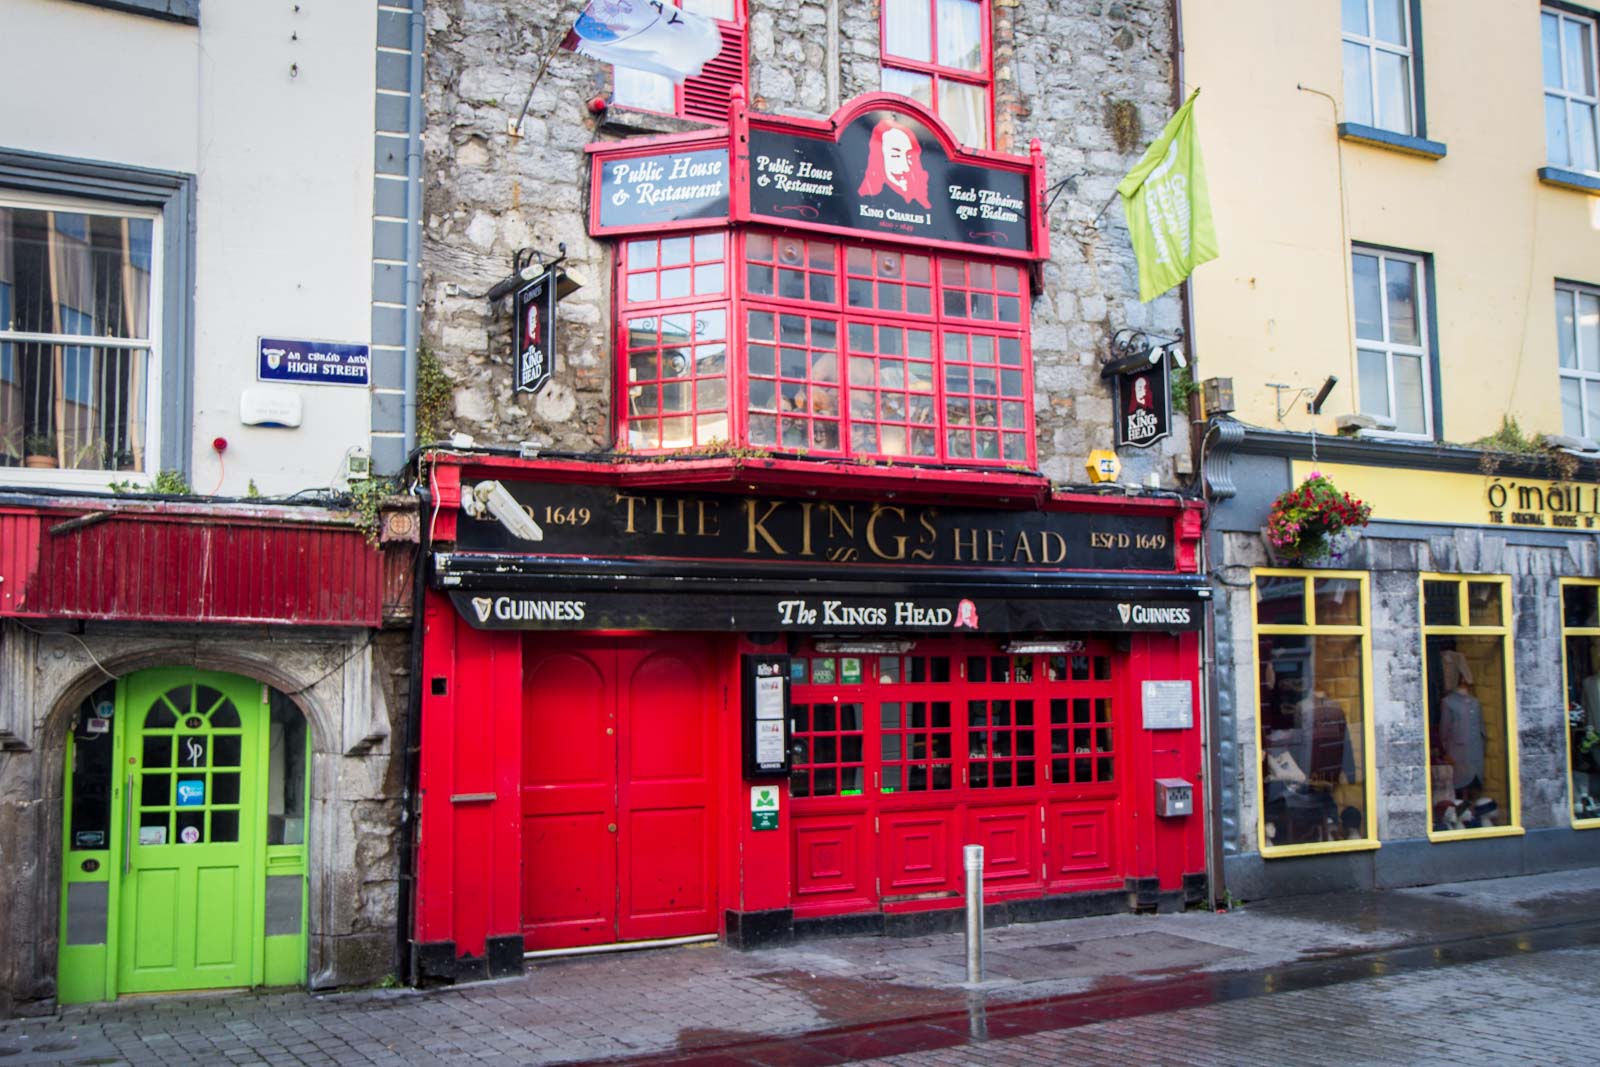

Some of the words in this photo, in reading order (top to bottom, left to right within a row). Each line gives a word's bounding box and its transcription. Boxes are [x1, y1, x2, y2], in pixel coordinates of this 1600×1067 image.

[612, 160, 665, 185] Public
[668, 157, 722, 181] House
[756, 155, 795, 175] Public
[796, 161, 833, 181] House
[612, 188, 630, 206] &
[635, 180, 723, 206] Restaurant
[756, 174, 771, 187] &
[774, 173, 834, 196] Restaurant
[948, 185, 977, 202] Teach
[956, 205, 978, 220] agus
[287, 362, 318, 374] HIGH
[322, 364, 367, 377] STREET
[522, 364, 542, 385] HEAD
[1128, 424, 1156, 440] HEAD
[545, 505, 591, 526] 1649
[616, 494, 721, 537] THE
[744, 500, 937, 561] KINGS
[953, 528, 1067, 564] HEAD
[1136, 533, 1166, 549] 1649
[494, 597, 585, 620] GUINNESS
[777, 600, 817, 625] The
[822, 600, 887, 625] KINGS
[894, 601, 952, 626] HEAD
[1132, 605, 1191, 624] GUINNESS
